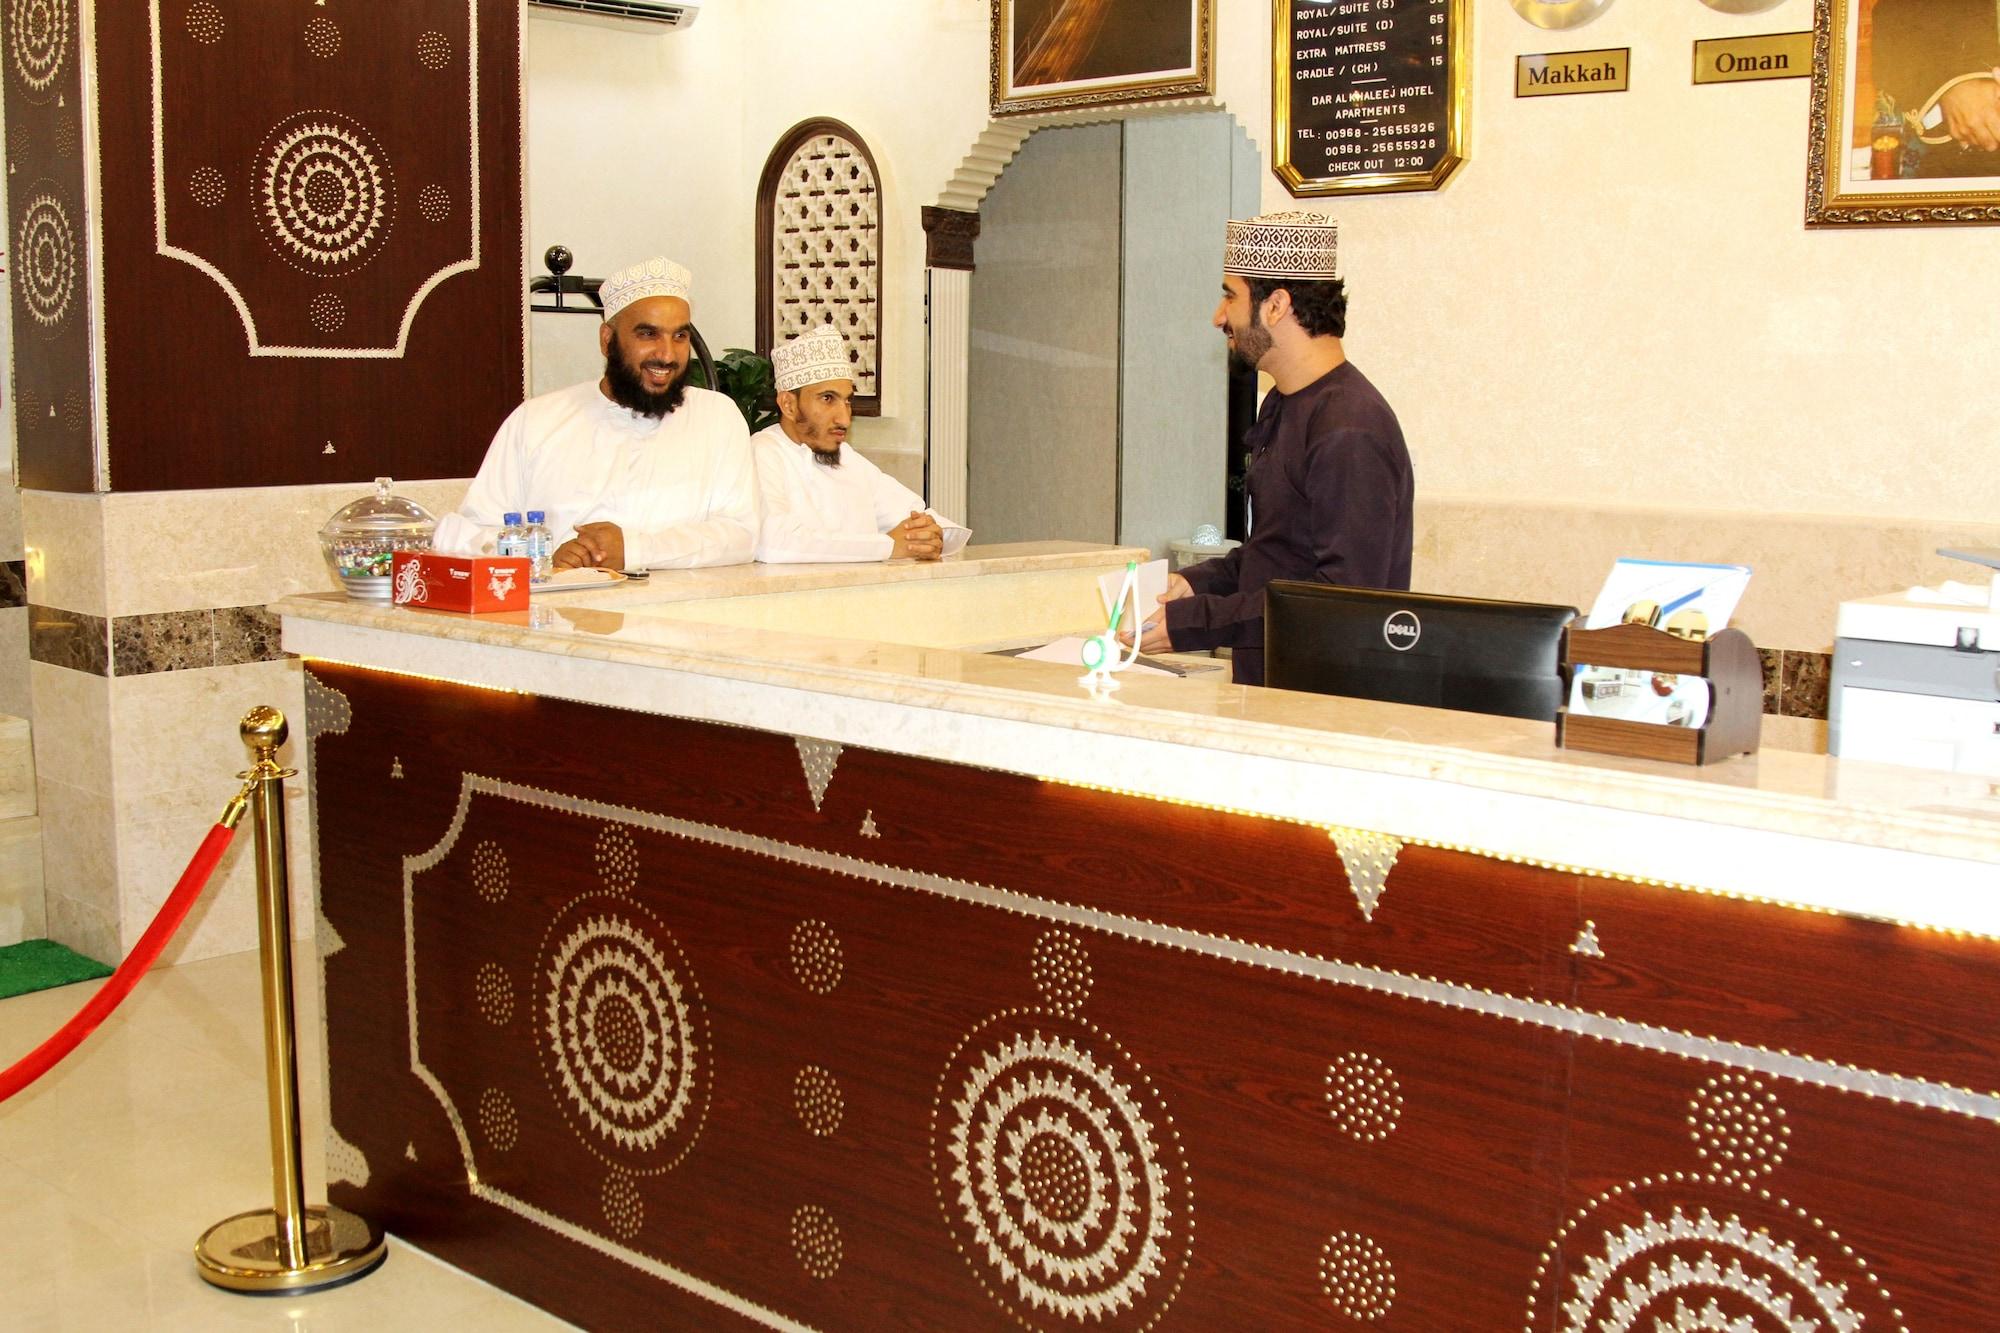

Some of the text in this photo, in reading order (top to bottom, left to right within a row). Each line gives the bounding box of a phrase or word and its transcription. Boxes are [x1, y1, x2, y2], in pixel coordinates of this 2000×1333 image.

[1376, 0, 1395, 10] (S)
[1376, 20, 1394, 31] (D)
[1429, 14, 1444, 24] 65
[1296, 35, 1443, 60] EXTRA MATTRESS 15
[1296, 67, 1335, 80] CRADLE
[1430, 56, 1443, 66] 15
[1715, 52, 1789, 74] Oman
[1528, 62, 1617, 86] Makkah
[1311, 95, 1332, 106] DAR
[1335, 93, 1347, 104] AL
[1400, 85, 1434, 98] HOTEL
[1335, 104, 1406, 120] APARTMENTS
[1328, 156, 1424, 173] CHECK OUT 12:00
[1388, 623, 1417, 637] DELL
